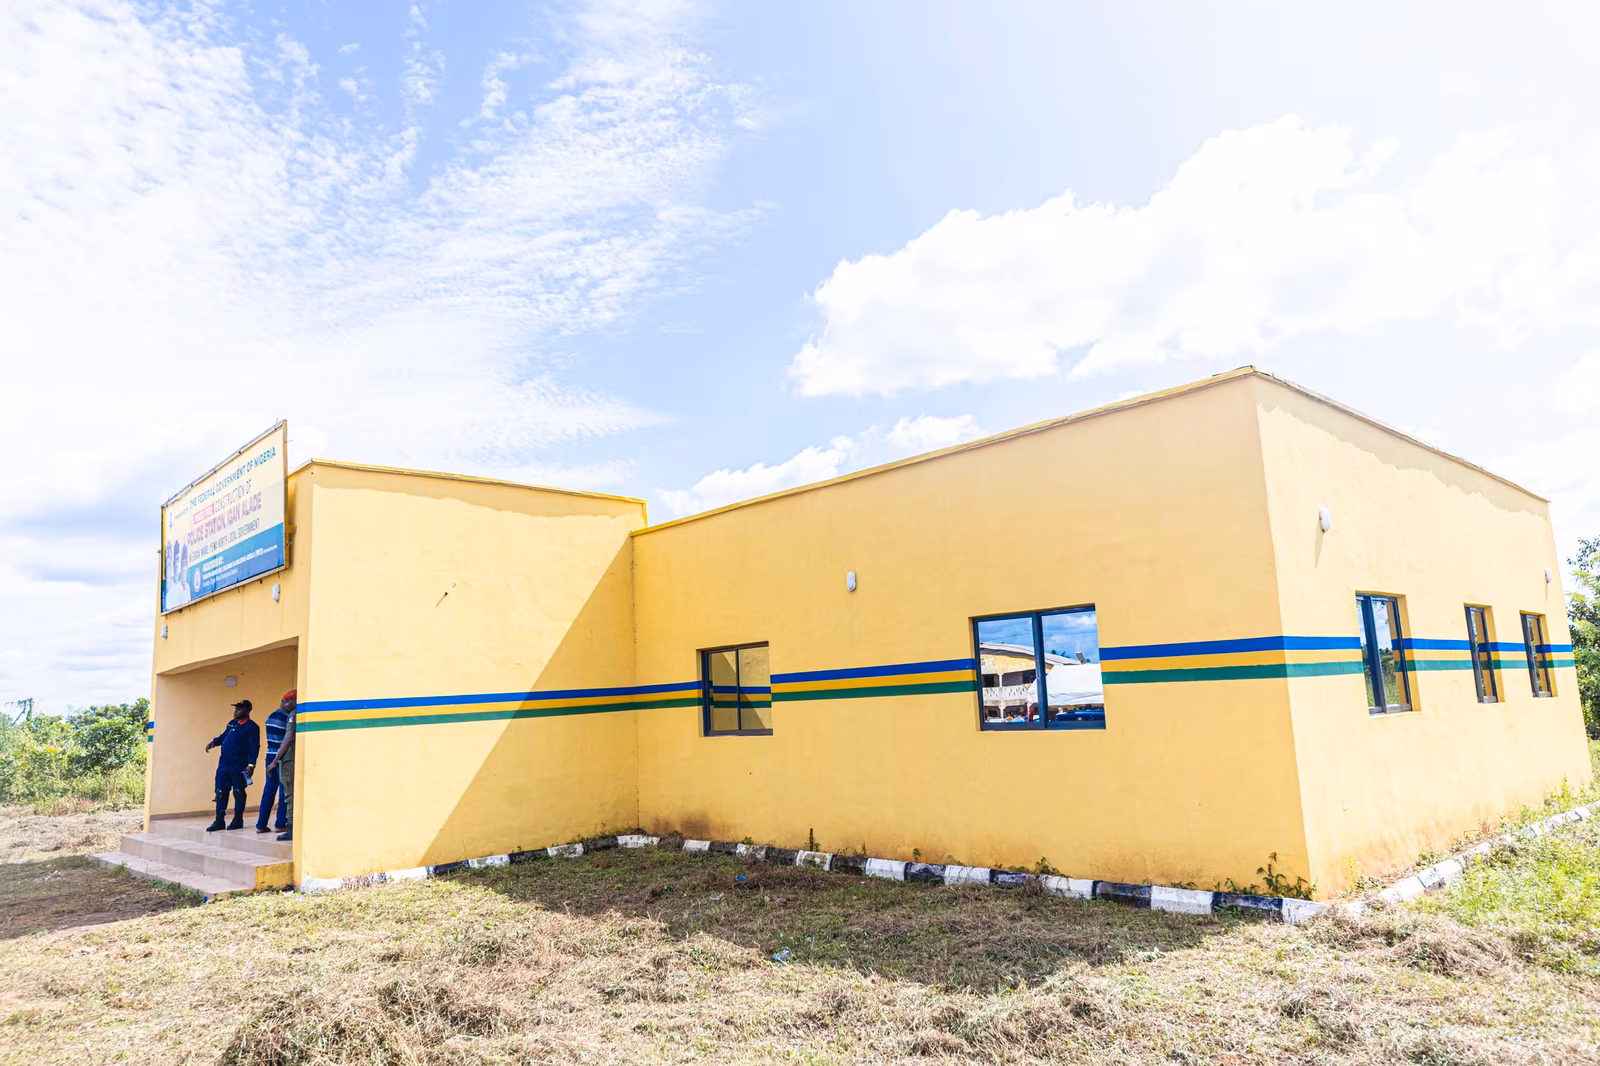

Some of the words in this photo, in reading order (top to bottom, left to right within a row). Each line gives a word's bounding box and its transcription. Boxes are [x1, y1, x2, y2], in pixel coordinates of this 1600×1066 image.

[198, 488, 215, 503] FEDERAL
[215, 465, 246, 492] GOVERNMENT
[246, 460, 253, 473] OF
[254, 446, 276, 468] NIGERIA
[215, 485, 245, 513] CONSTRUCTION
[246, 479, 252, 494] OF
[187, 525, 203, 547] POLICE
[242, 492, 262, 518] ALADE
